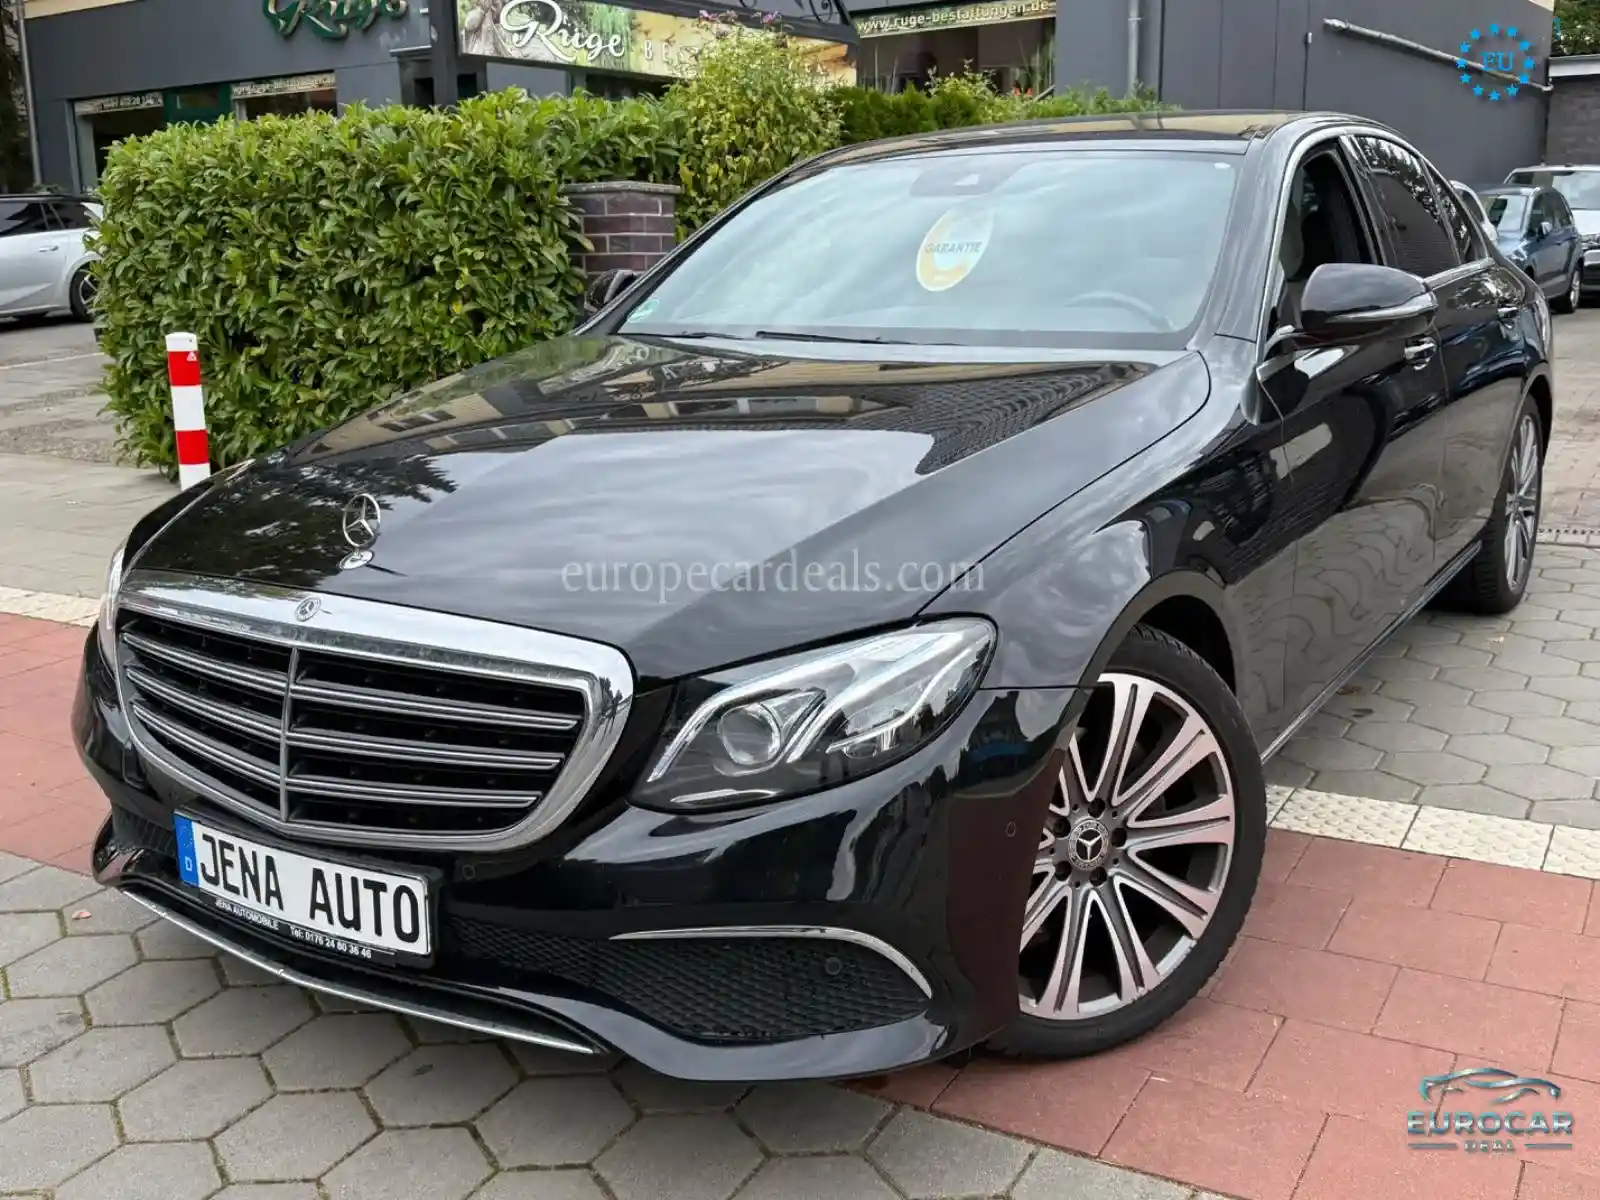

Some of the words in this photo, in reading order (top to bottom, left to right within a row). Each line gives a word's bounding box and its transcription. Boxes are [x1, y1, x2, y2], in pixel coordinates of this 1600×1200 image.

[499, 0, 625, 62] Ruge
[856, 0, 1051, 32] www.ruge-bestattungen.de
[925, 241, 982, 254] GARANTIE
[184, 855, 193, 872] D
[200, 832, 284, 911] JENA
[309, 867, 420, 943] AUTO
